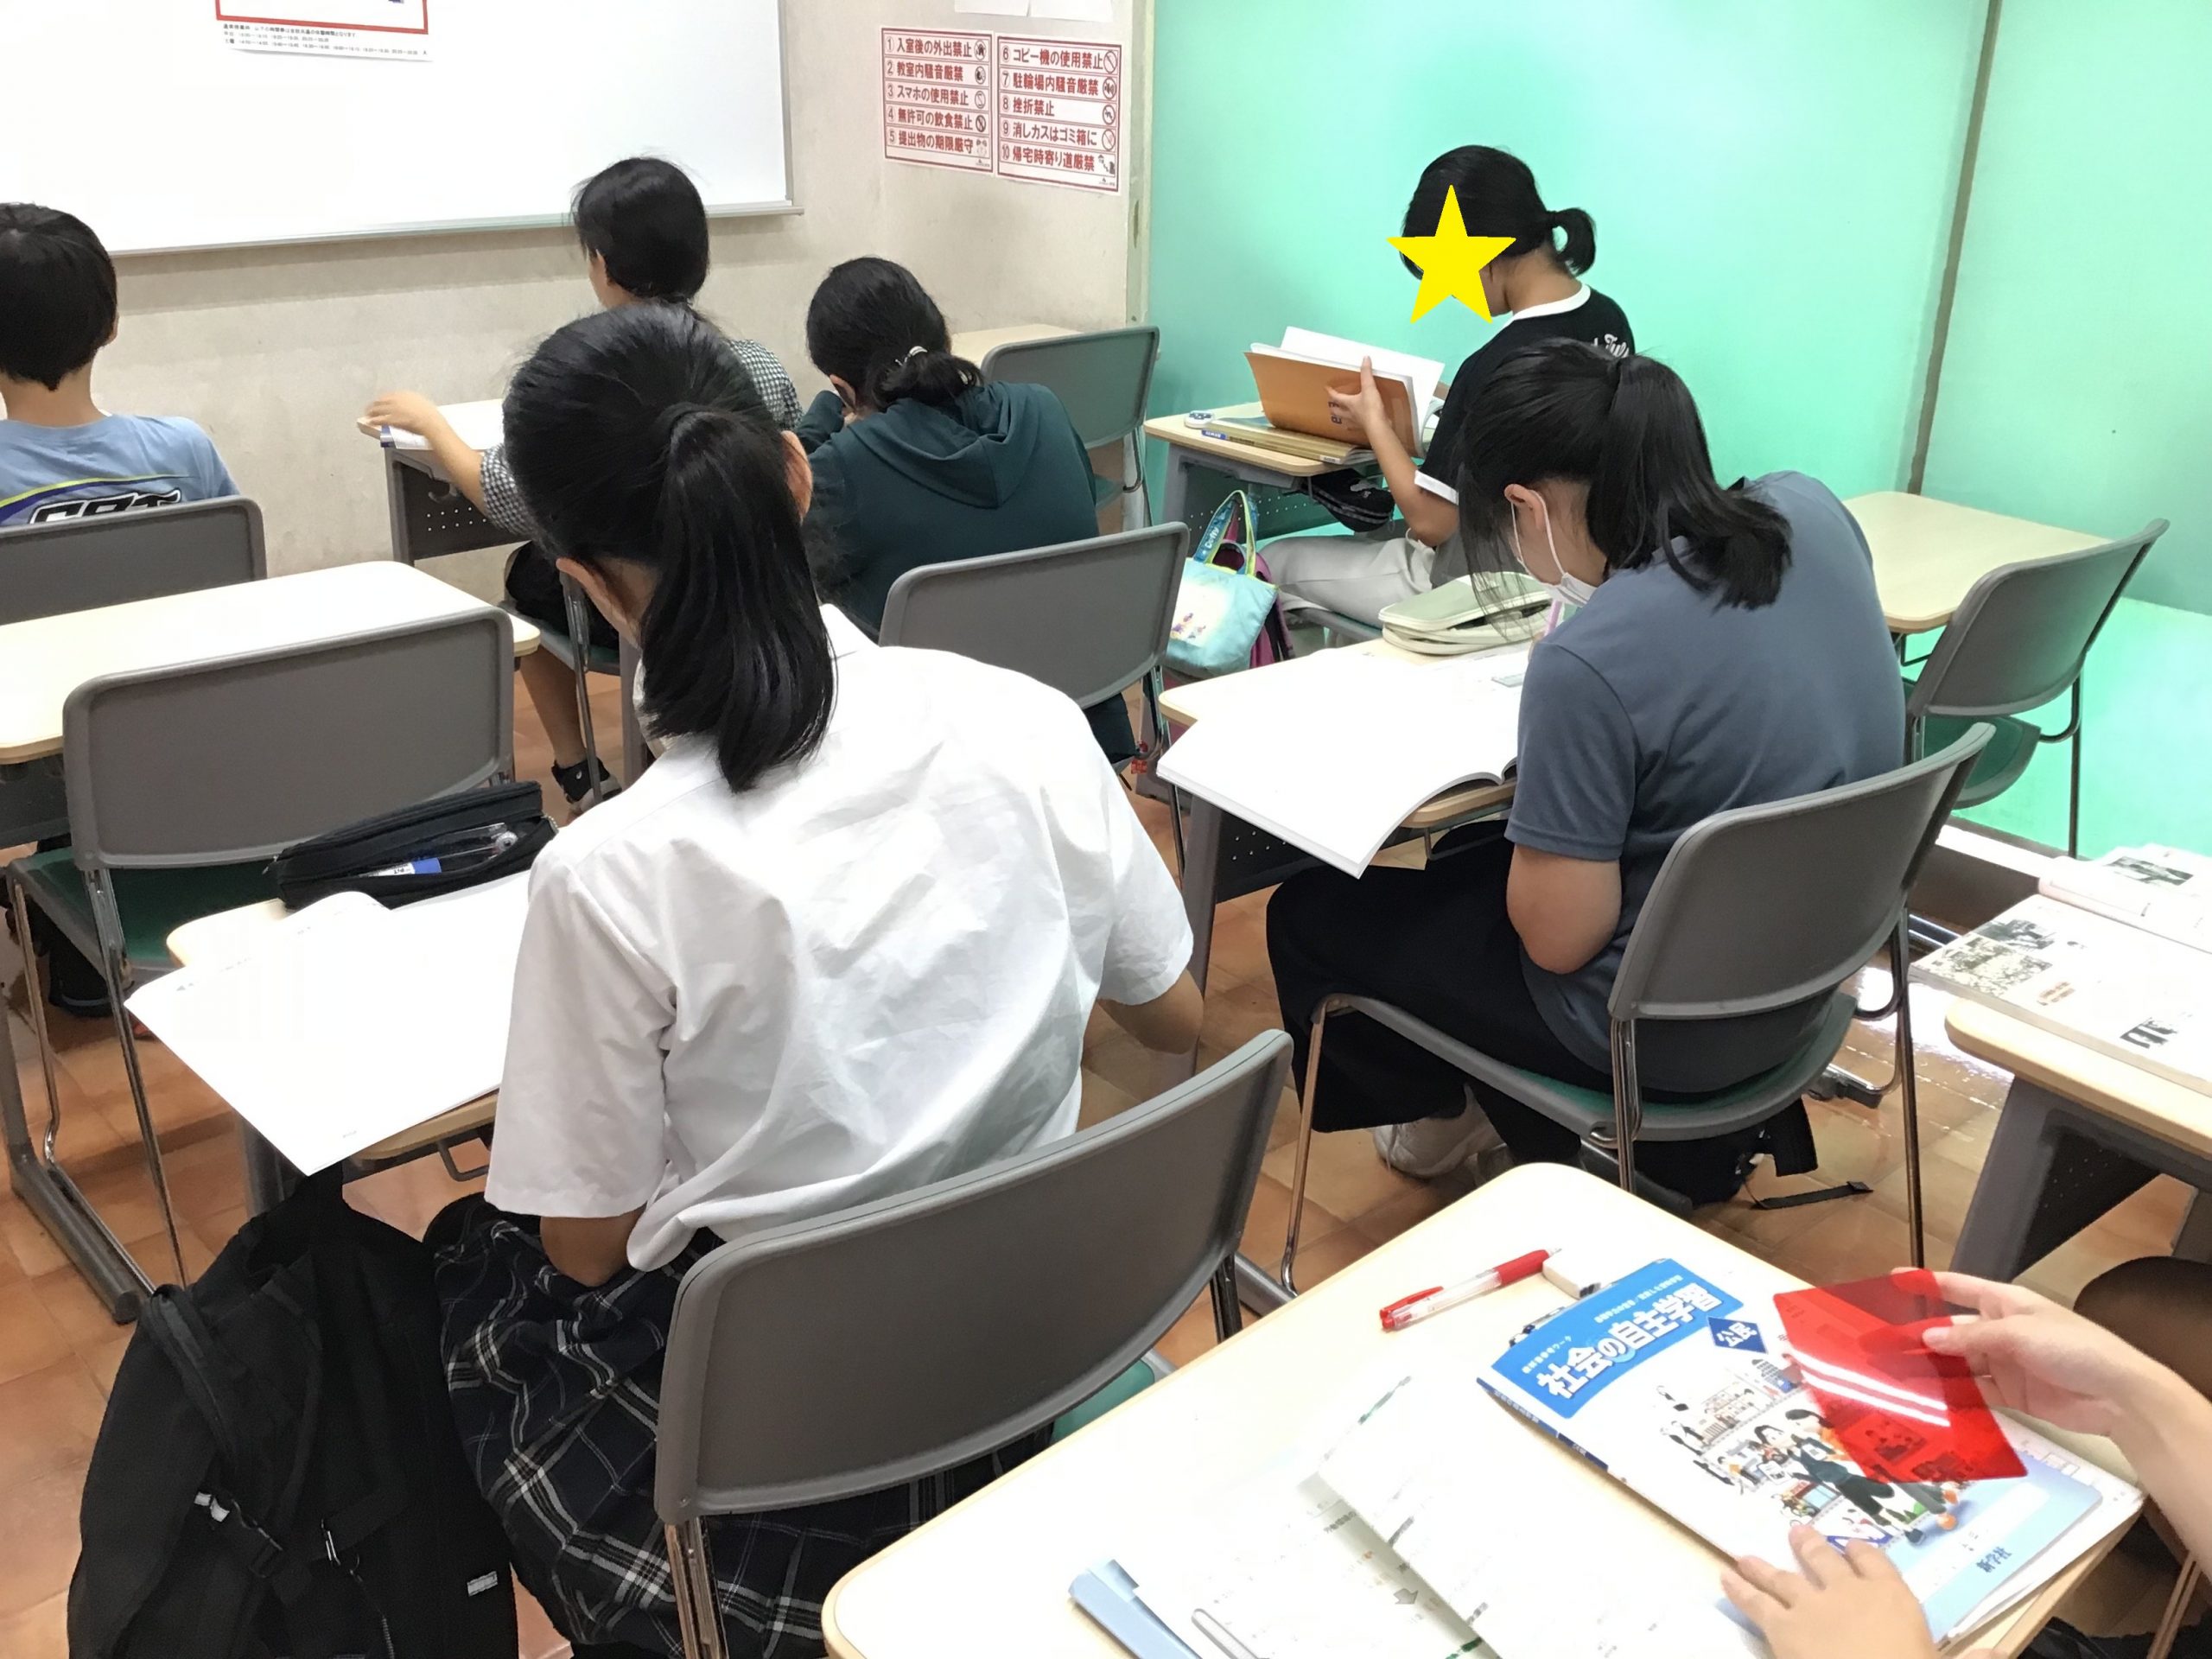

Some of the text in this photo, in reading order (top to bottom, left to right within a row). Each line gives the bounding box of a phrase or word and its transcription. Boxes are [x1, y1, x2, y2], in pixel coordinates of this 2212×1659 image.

[897, 38, 972, 57] 入室後の外出禁止
[1014, 48, 1103, 69] コピー機の使用禁止
[897, 60, 963, 81] 教室内騒音厳禁
[897, 85, 969, 105] スマホの使用禁止
[1013, 73, 1098, 96] 駐輪場内騒音厳禁
[1013, 97, 1055, 117] 挫折禁止
[898, 108, 973, 130] 無許可の飲食禁止
[899, 130, 973, 153] 提出物の期限厳守
[1013, 122, 1097, 146] 消しカスはゴミ箱に
[1013, 145, 1095, 171] 帰宅時寄り道厳禁
[1536, 1282, 1723, 1399] 社会の自主学習
[1716, 1322, 1758, 1347] 公民
